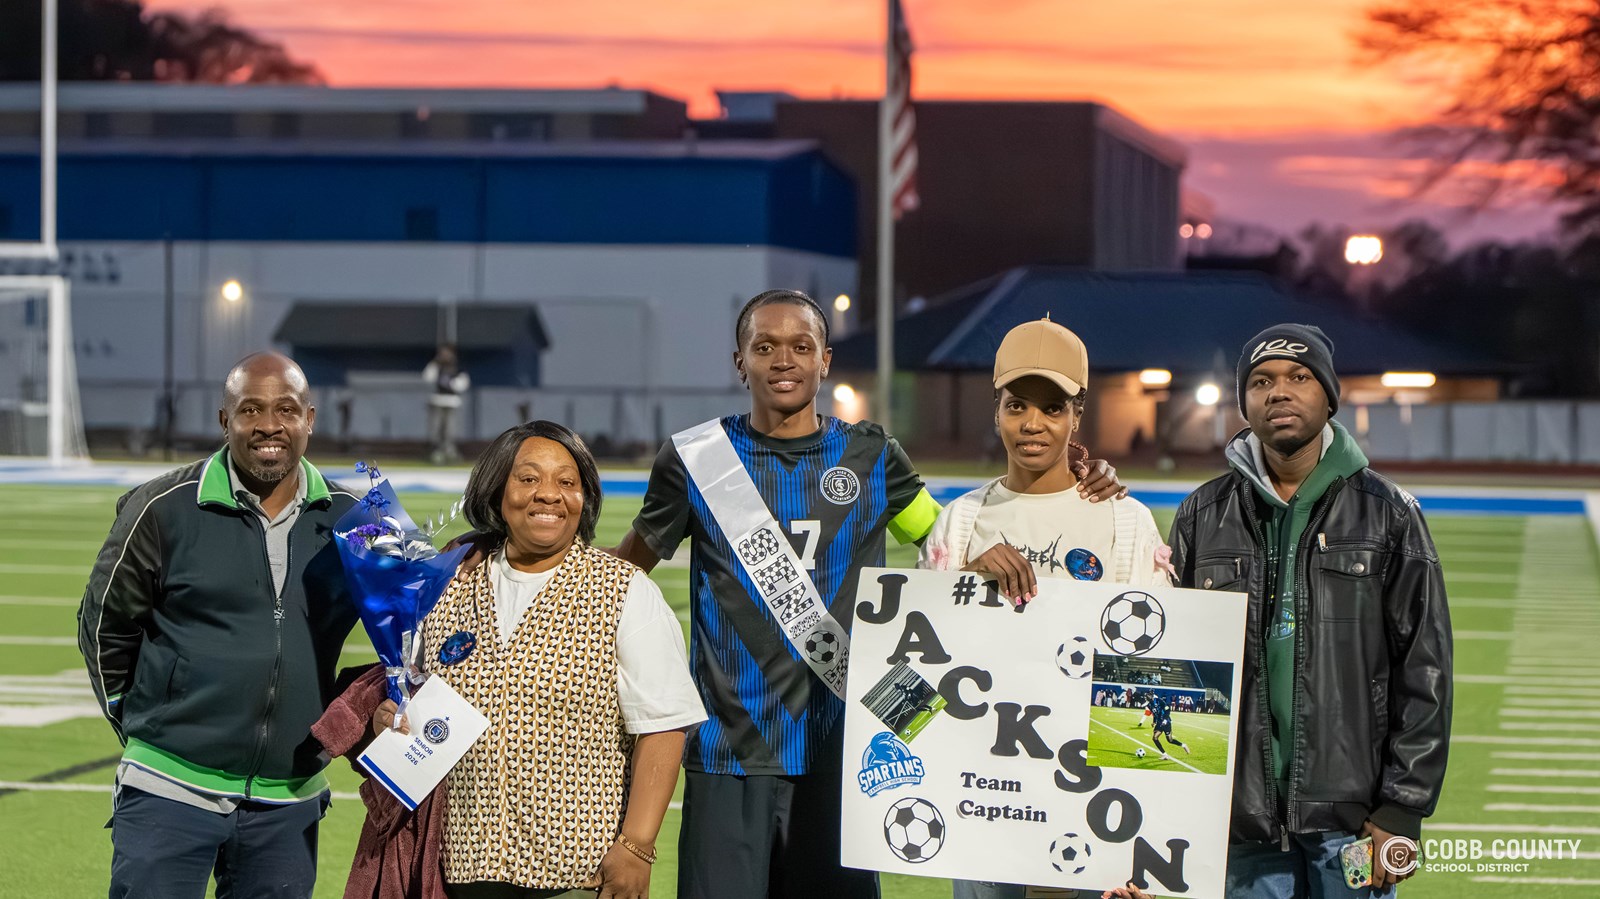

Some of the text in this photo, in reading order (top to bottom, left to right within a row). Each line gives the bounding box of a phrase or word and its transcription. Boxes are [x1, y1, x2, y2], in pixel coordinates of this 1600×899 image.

[790, 520, 821, 570] 7
[952, 575, 1028, 613] #1
[409, 744, 426, 759] NIGHT
[414, 737, 433, 755] SENIOR
[404, 751, 418, 765] 2026
[858, 758, 924, 792] SPARTANS
[960, 772, 1022, 792] Team
[958, 799, 1047, 822] Captain
